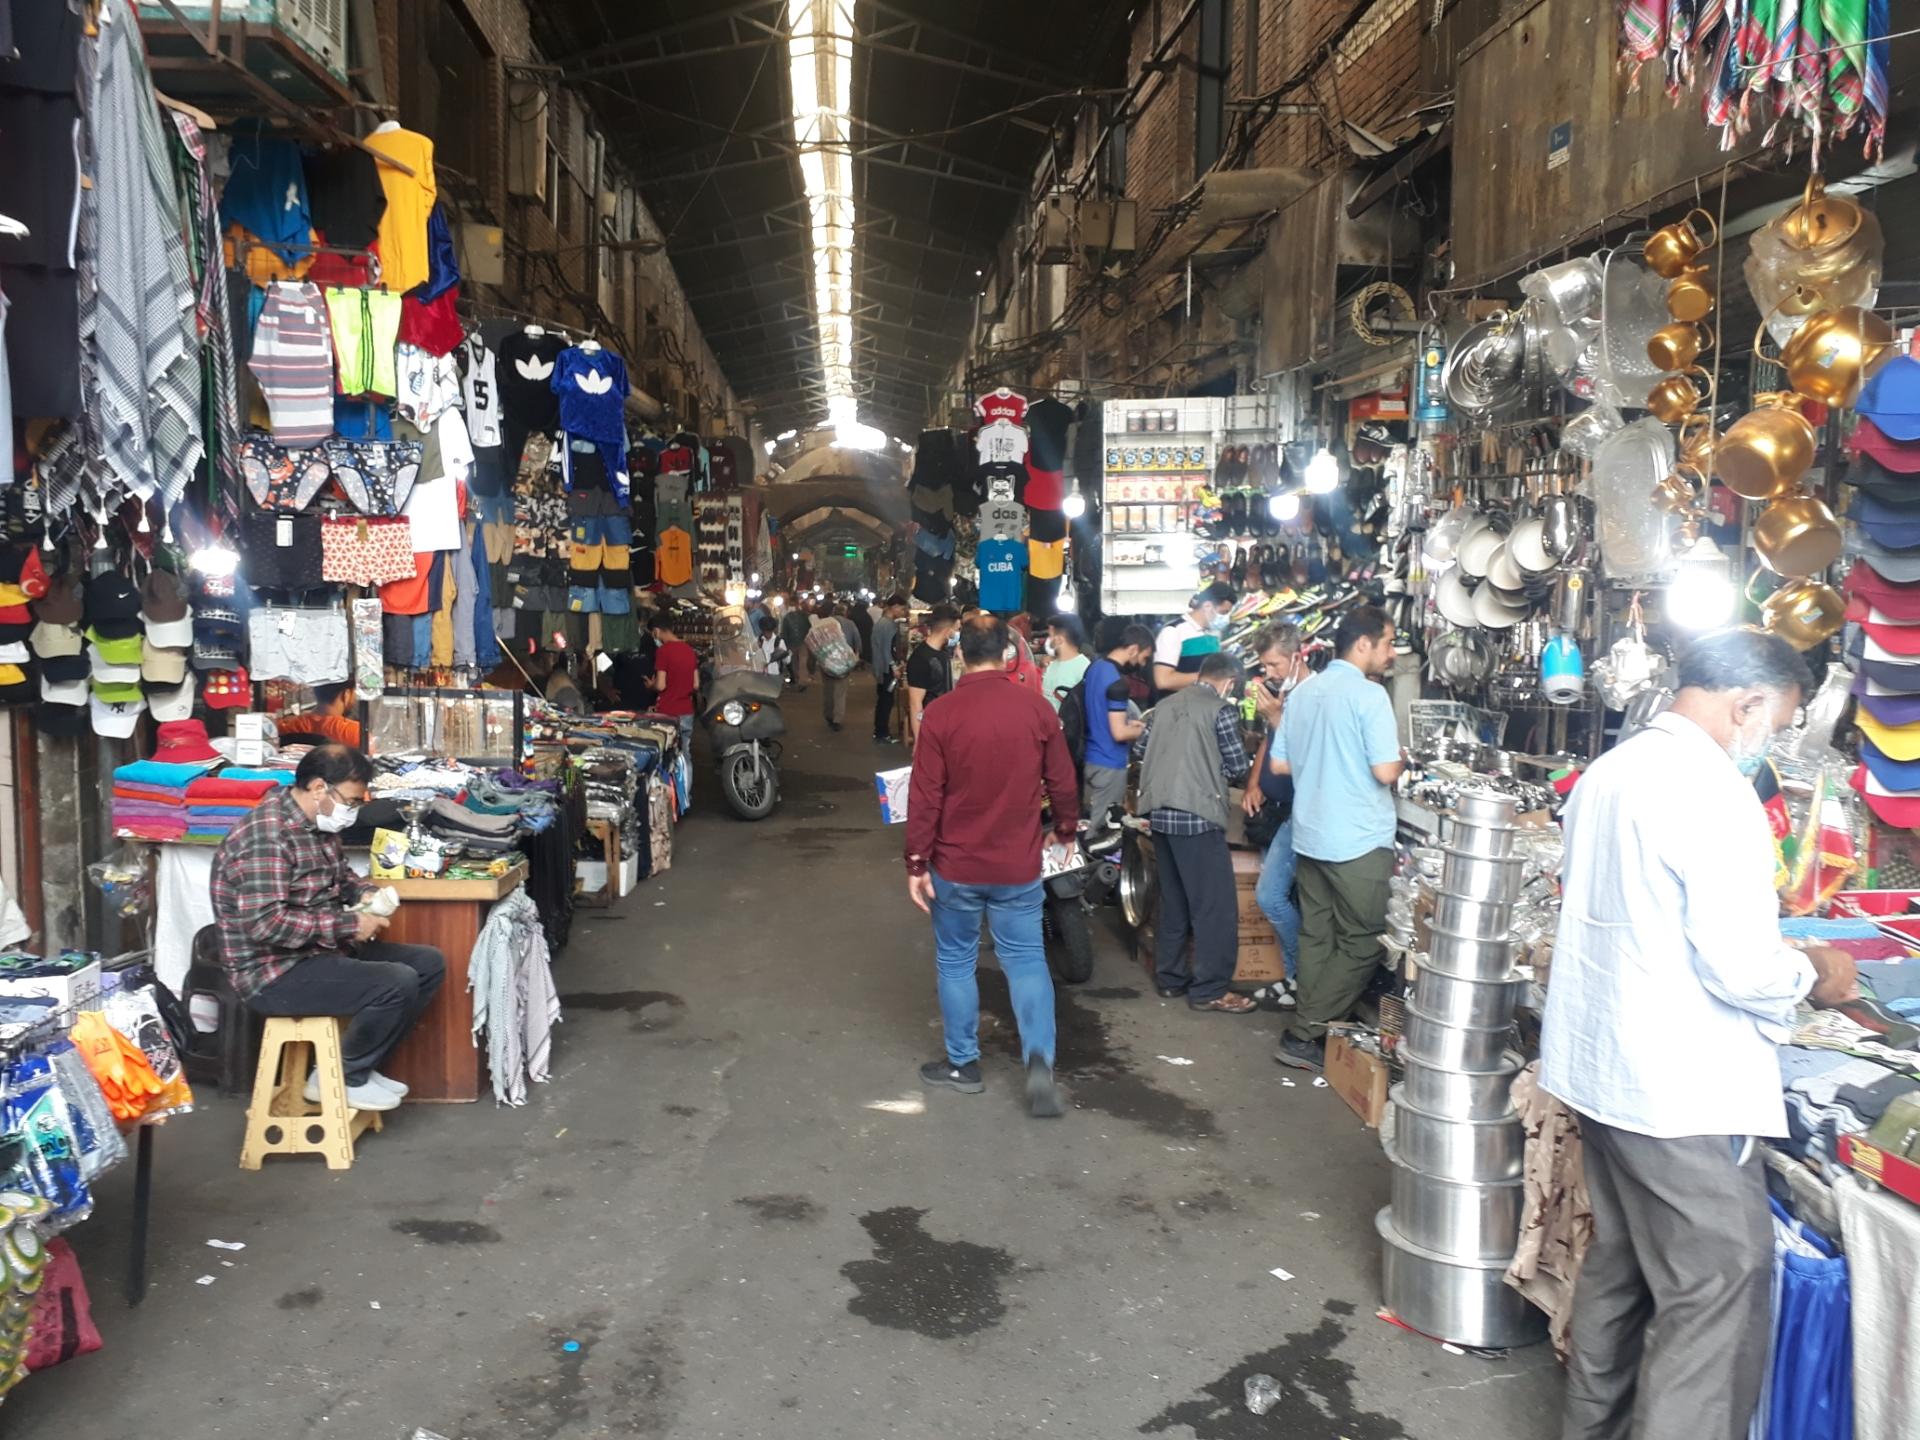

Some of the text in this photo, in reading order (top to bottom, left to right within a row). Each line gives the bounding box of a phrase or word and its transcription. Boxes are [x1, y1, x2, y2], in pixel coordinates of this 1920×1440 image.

[473, 379, 489, 410] 5
[992, 507, 1018, 519] das
[987, 561, 1014, 572] CUBA
